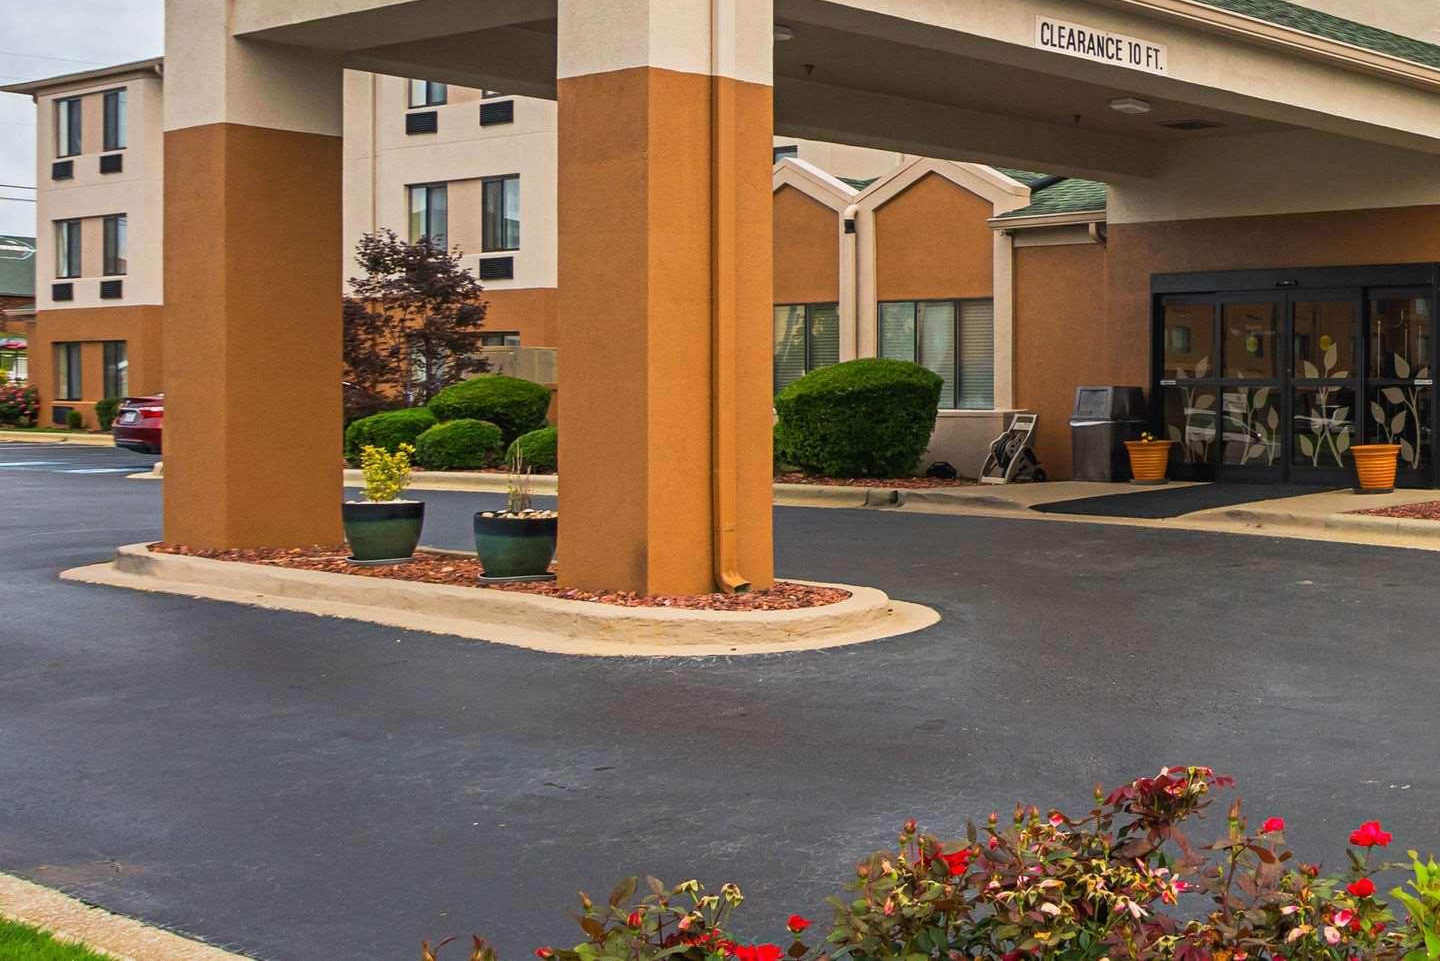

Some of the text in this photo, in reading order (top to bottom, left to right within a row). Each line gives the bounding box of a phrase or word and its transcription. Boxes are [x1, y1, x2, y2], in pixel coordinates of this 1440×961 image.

[1040, 22, 1163, 70] CLEARANCE 10 FT.
